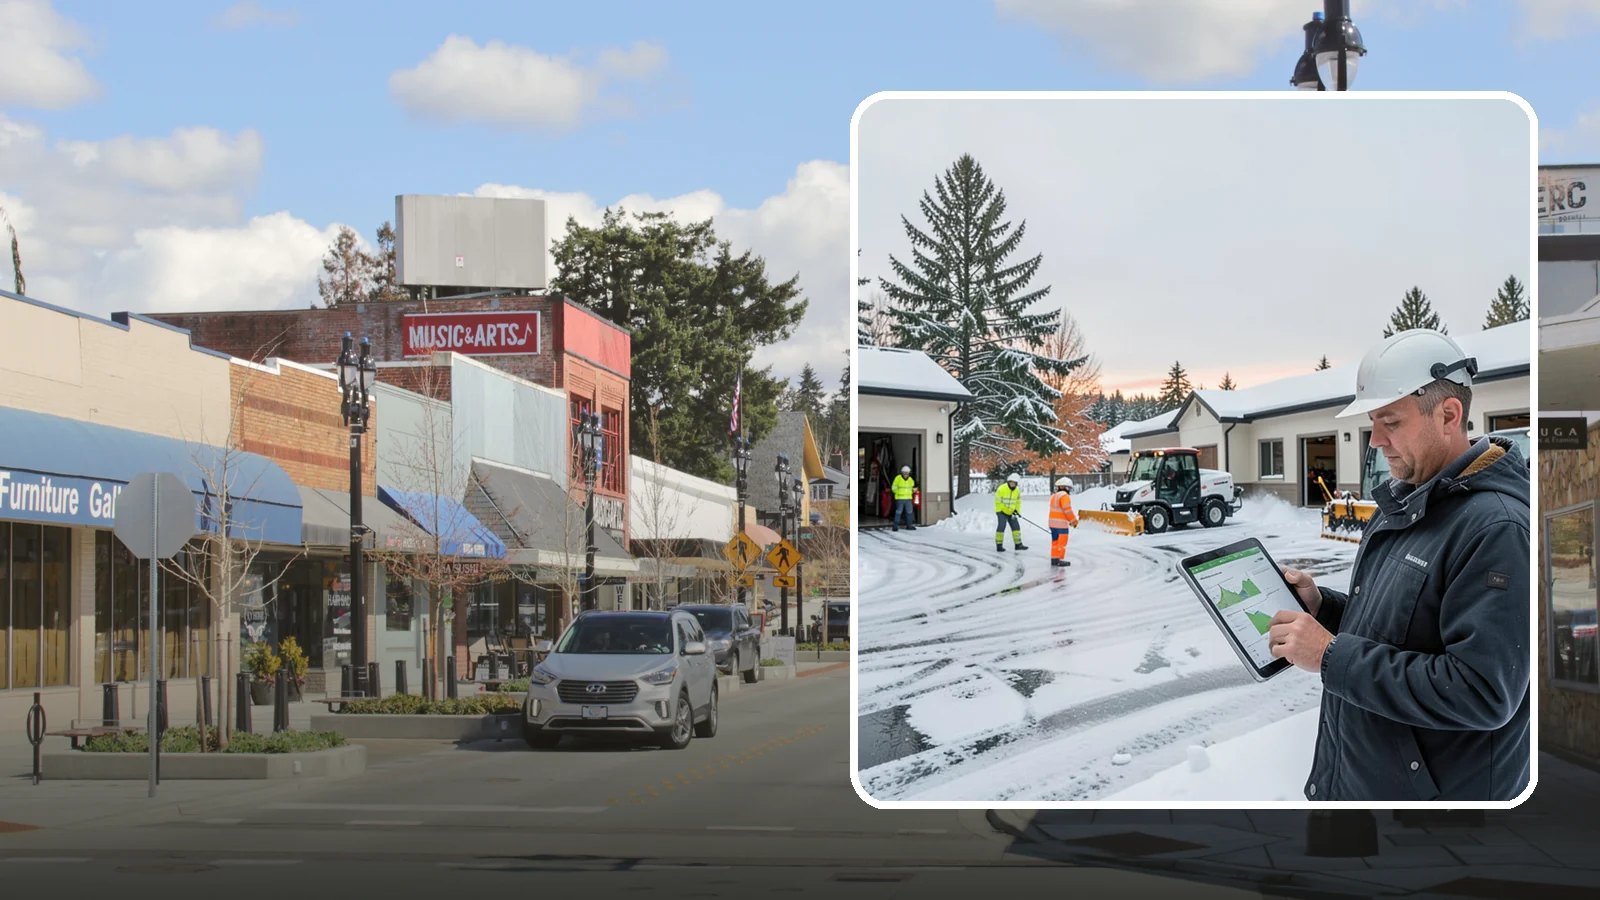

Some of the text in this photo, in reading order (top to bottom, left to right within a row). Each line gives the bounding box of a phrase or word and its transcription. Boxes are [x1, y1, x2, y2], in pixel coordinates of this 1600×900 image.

[408, 322, 519, 349] MUSIC&ARTS
[1540, 427, 1577, 436] UGA
[0, 471, 121, 519] Furniture Gal
[453, 563, 479, 575] SUSHI
